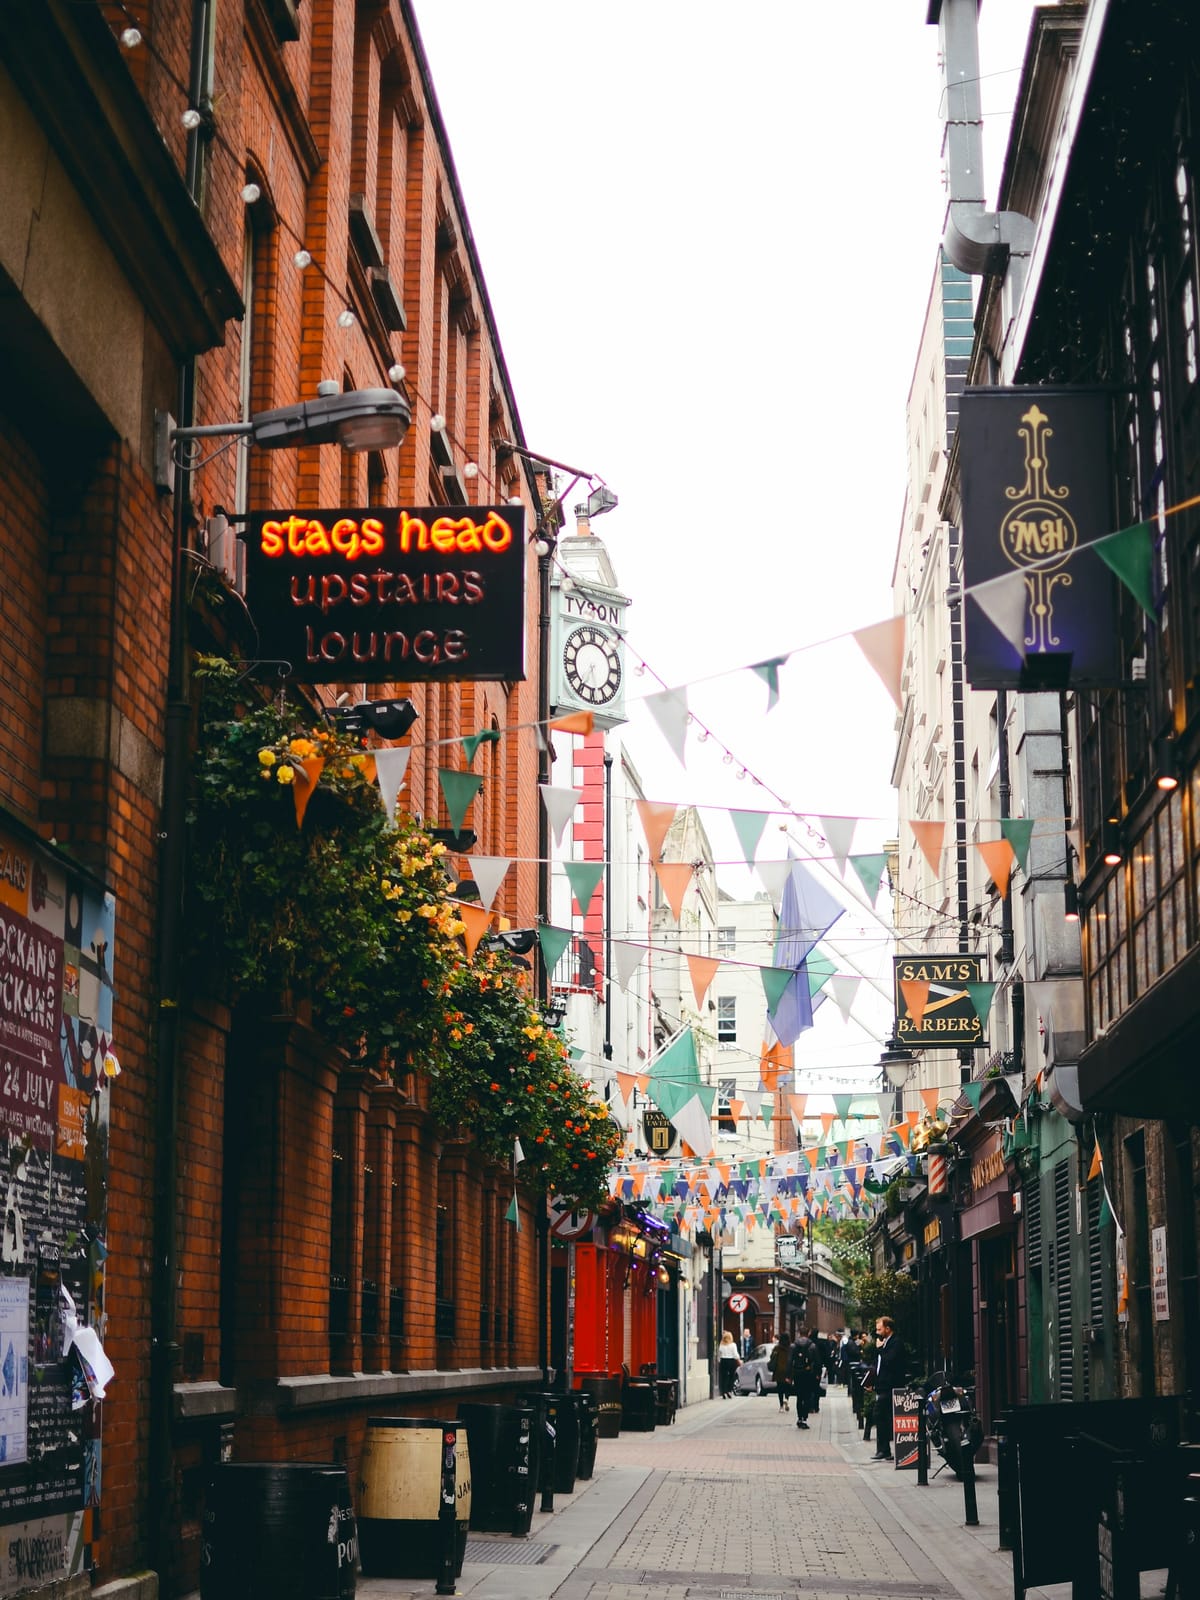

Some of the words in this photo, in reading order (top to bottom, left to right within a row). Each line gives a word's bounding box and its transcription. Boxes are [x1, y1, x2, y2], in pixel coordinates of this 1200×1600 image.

[902, 963, 970, 981] SAM'S
[3, 1062, 20, 1099] 24
[23, 1070, 54, 1110] JULY
